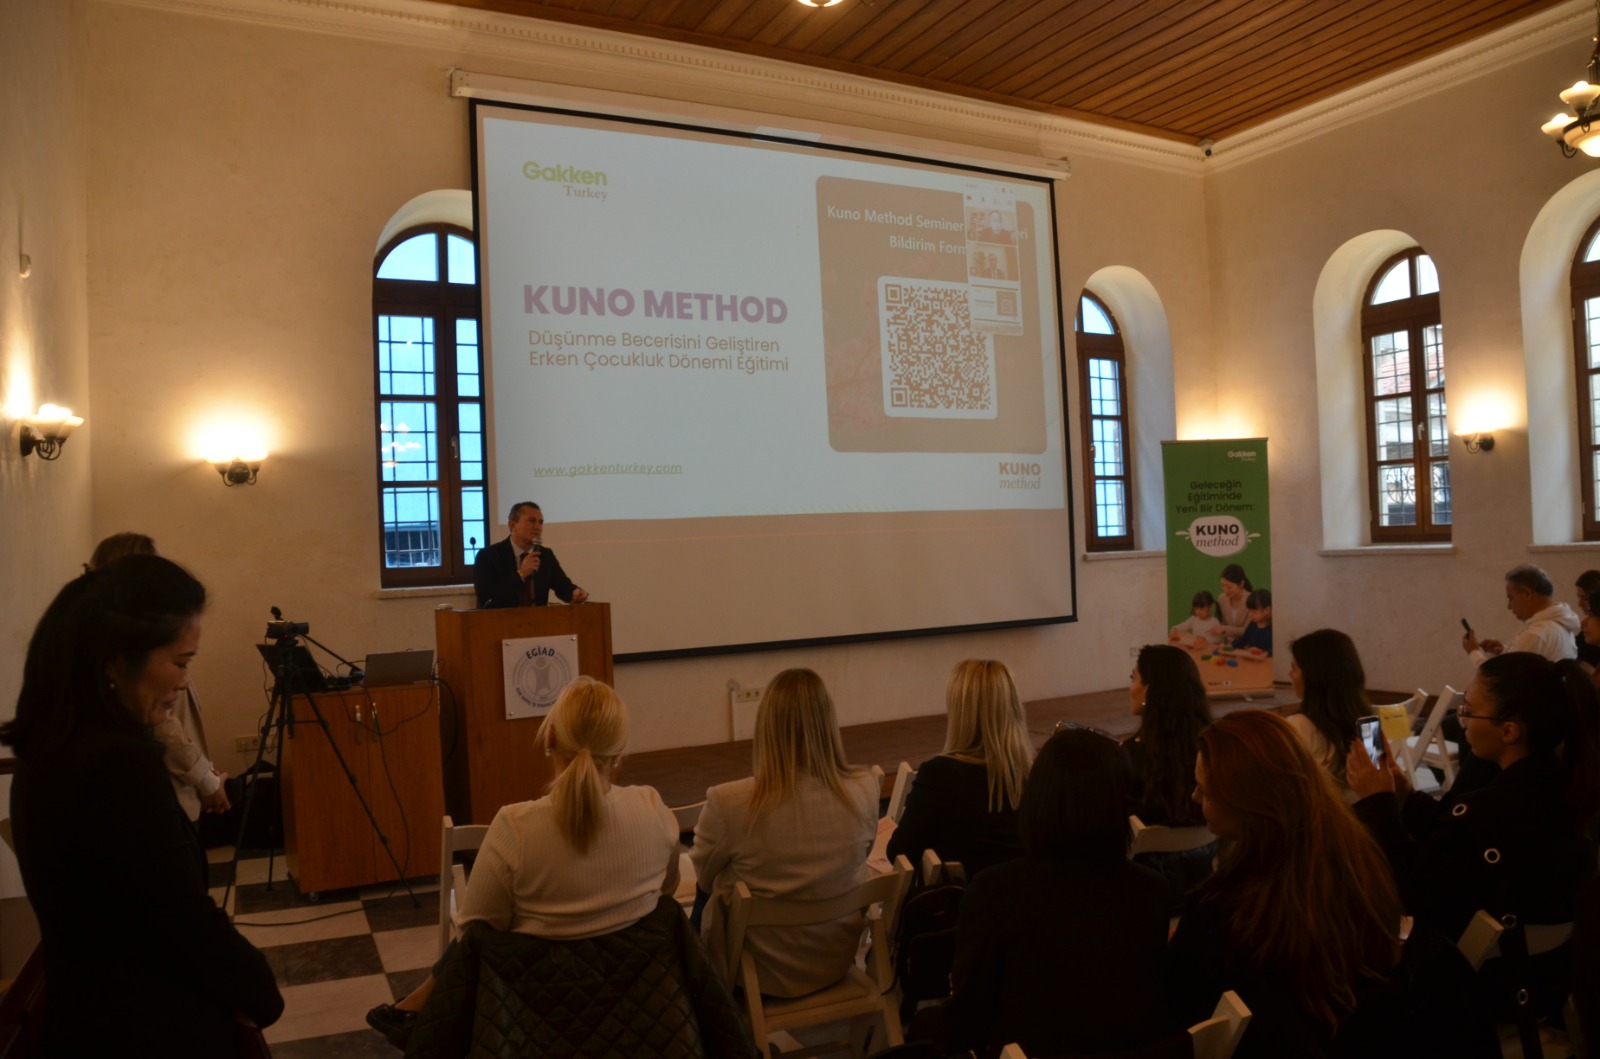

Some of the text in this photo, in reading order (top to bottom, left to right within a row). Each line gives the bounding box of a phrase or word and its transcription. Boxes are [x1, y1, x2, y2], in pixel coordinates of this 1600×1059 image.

[522, 161, 608, 186] Gakken
[563, 185, 608, 203] Turkey
[827, 205, 861, 220] Kuno
[864, 209, 913, 226] Method
[889, 235, 966, 255] Bildirim Form
[524, 285, 788, 324] KUNO METHOD
[529, 330, 780, 355] Düşünme Becerisini Geliştiren
[529, 351, 789, 375] Erken Çocukluk Dönemi Eğitimi
[533, 463, 683, 477] www.gakkenturkey.com
[999, 462, 1041, 476] KUNO
[1000, 476, 1041, 490] method
[1190, 480, 1242, 491] Geleceğin
[1188, 492, 1242, 504] Eğitiminde
[1175, 502, 1256, 514] Yeni Bir Dönem:
[1196, 524, 1239, 536] KUNO
[1196, 535, 1239, 547] method
[525, 645, 556, 660] EGİAD
